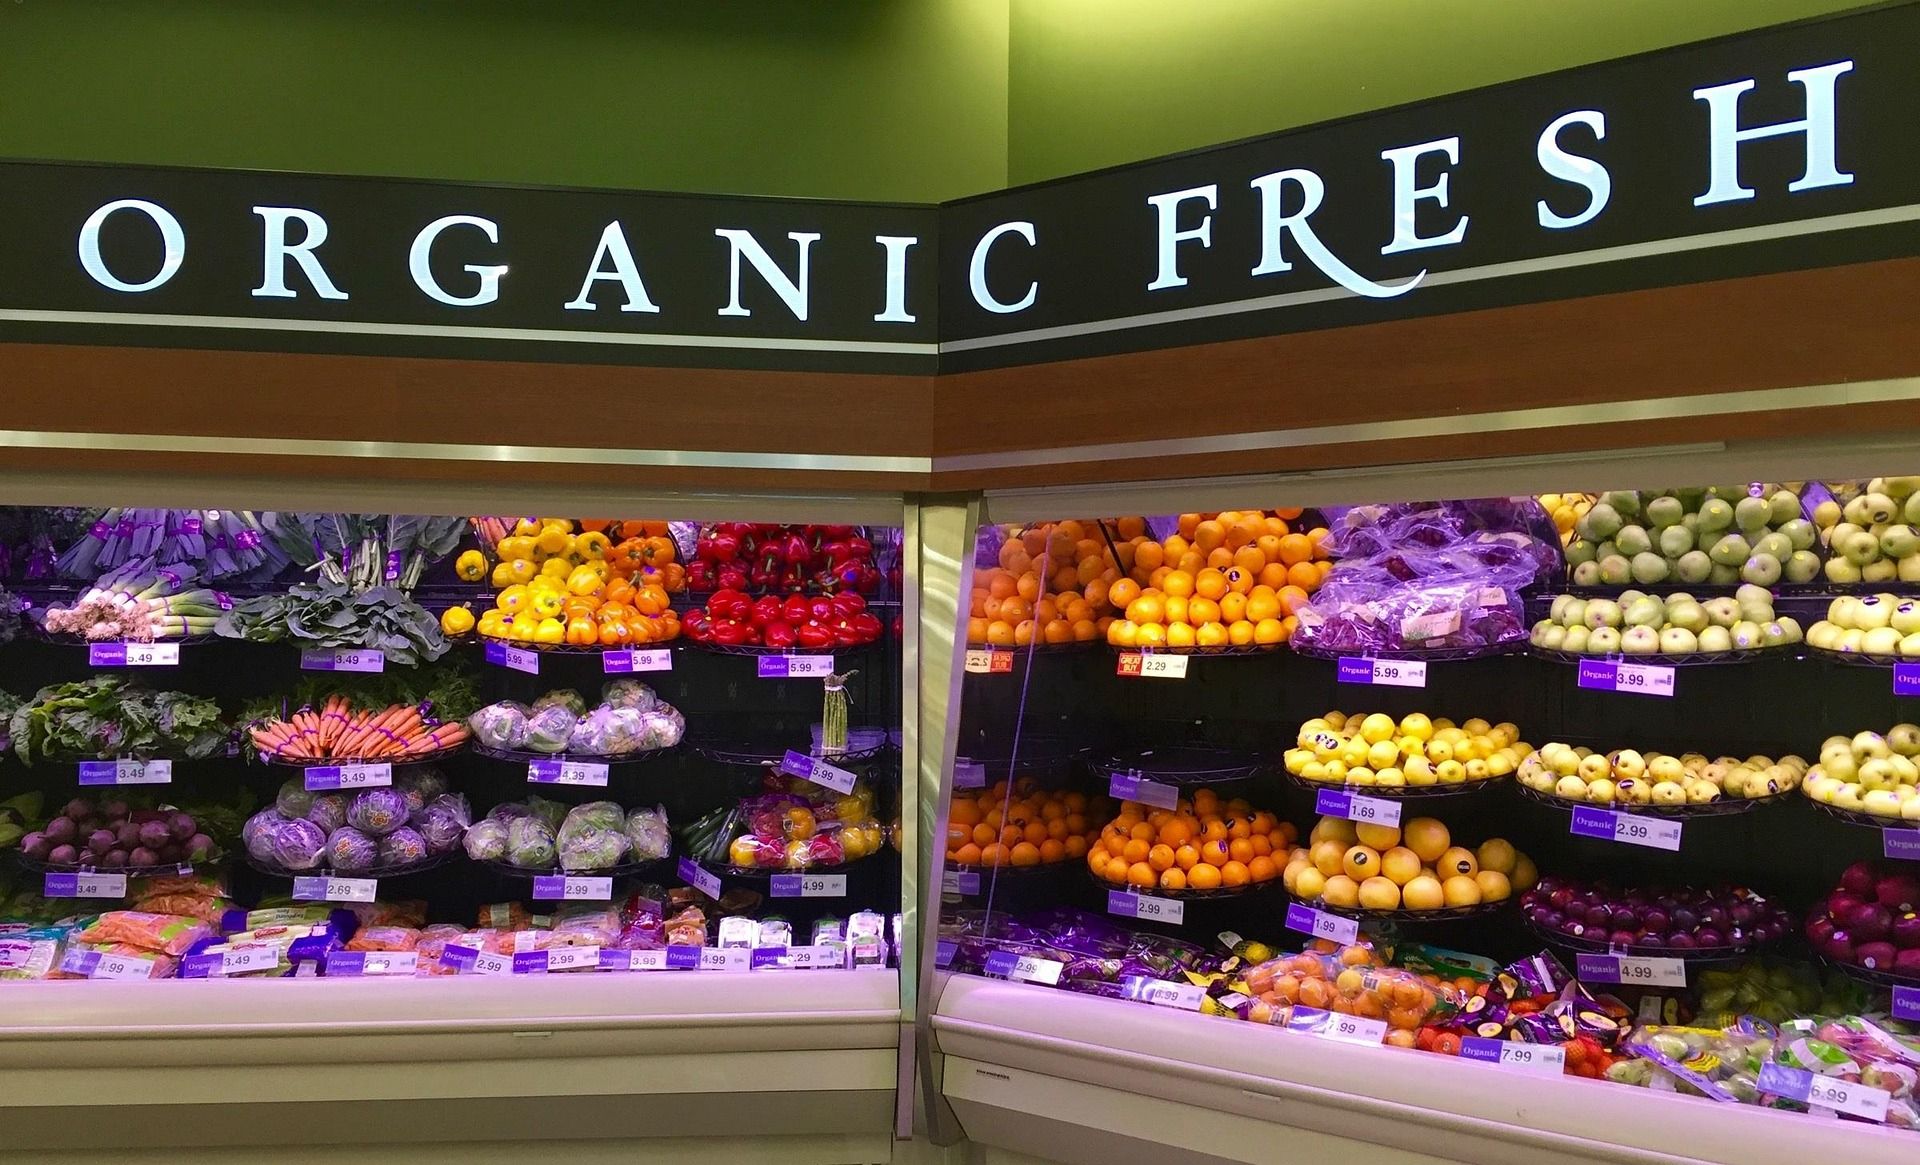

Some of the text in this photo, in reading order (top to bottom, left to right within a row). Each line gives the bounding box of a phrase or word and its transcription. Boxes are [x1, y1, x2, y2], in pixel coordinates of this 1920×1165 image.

[78, 60, 1855, 323] ORGANIC FRESH
[94, 650, 123, 661] Organic
[336, 655, 359, 665] 3.49
[633, 656, 652, 666] 5.99
[760, 660, 788, 672] Organic
[791, 661, 813, 673] 5.99
[1146, 661, 1166, 671] 2.29
[1341, 666, 1371, 677] Organic
[1374, 667, 1399, 678] 5.99
[1583, 668, 1615, 680] Organic
[1617, 673, 1643, 686] 3.99
[785, 758, 812, 774] Organic
[120, 769, 145, 779] 3.49
[341, 772, 366, 784] 3.49
[562, 768, 586, 780] 4.39
[812, 764, 834, 781] 5.99
[1320, 799, 1347, 811] Organic
[1352, 805, 1374, 818] 1.69
[1576, 815, 1612, 831] Organic
[1616, 822, 1647, 838] 2.99
[78, 884, 97, 894] 3.49
[328, 884, 351, 895] 2.69
[536, 883, 562, 895] Organic
[566, 884, 588, 895] 2.99
[773, 882, 801, 893] Organic
[803, 882, 824, 892] 4.99
[1110, 898, 1137, 910] Organic
[1139, 902, 1160, 914] 2.99
[1315, 919, 1335, 932] 1.99
[224, 954, 250, 967] 3.49
[331, 957, 361, 969] Organic
[550, 954, 574, 965] 2.99
[633, 955, 657, 967] 3.99
[702, 953, 726, 965] 4.99
[477, 959, 502, 973] 2.99
[1018, 962, 1038, 974] 2.99
[1580, 963, 1616, 976] Organic
[1622, 966, 1652, 978] 4.99
[1154, 988, 1179, 1002] 6.99
[1463, 1047, 1497, 1060] Organic
[1503, 1049, 1531, 1063] 7.99
[1811, 1085, 1848, 1104] 6.99
